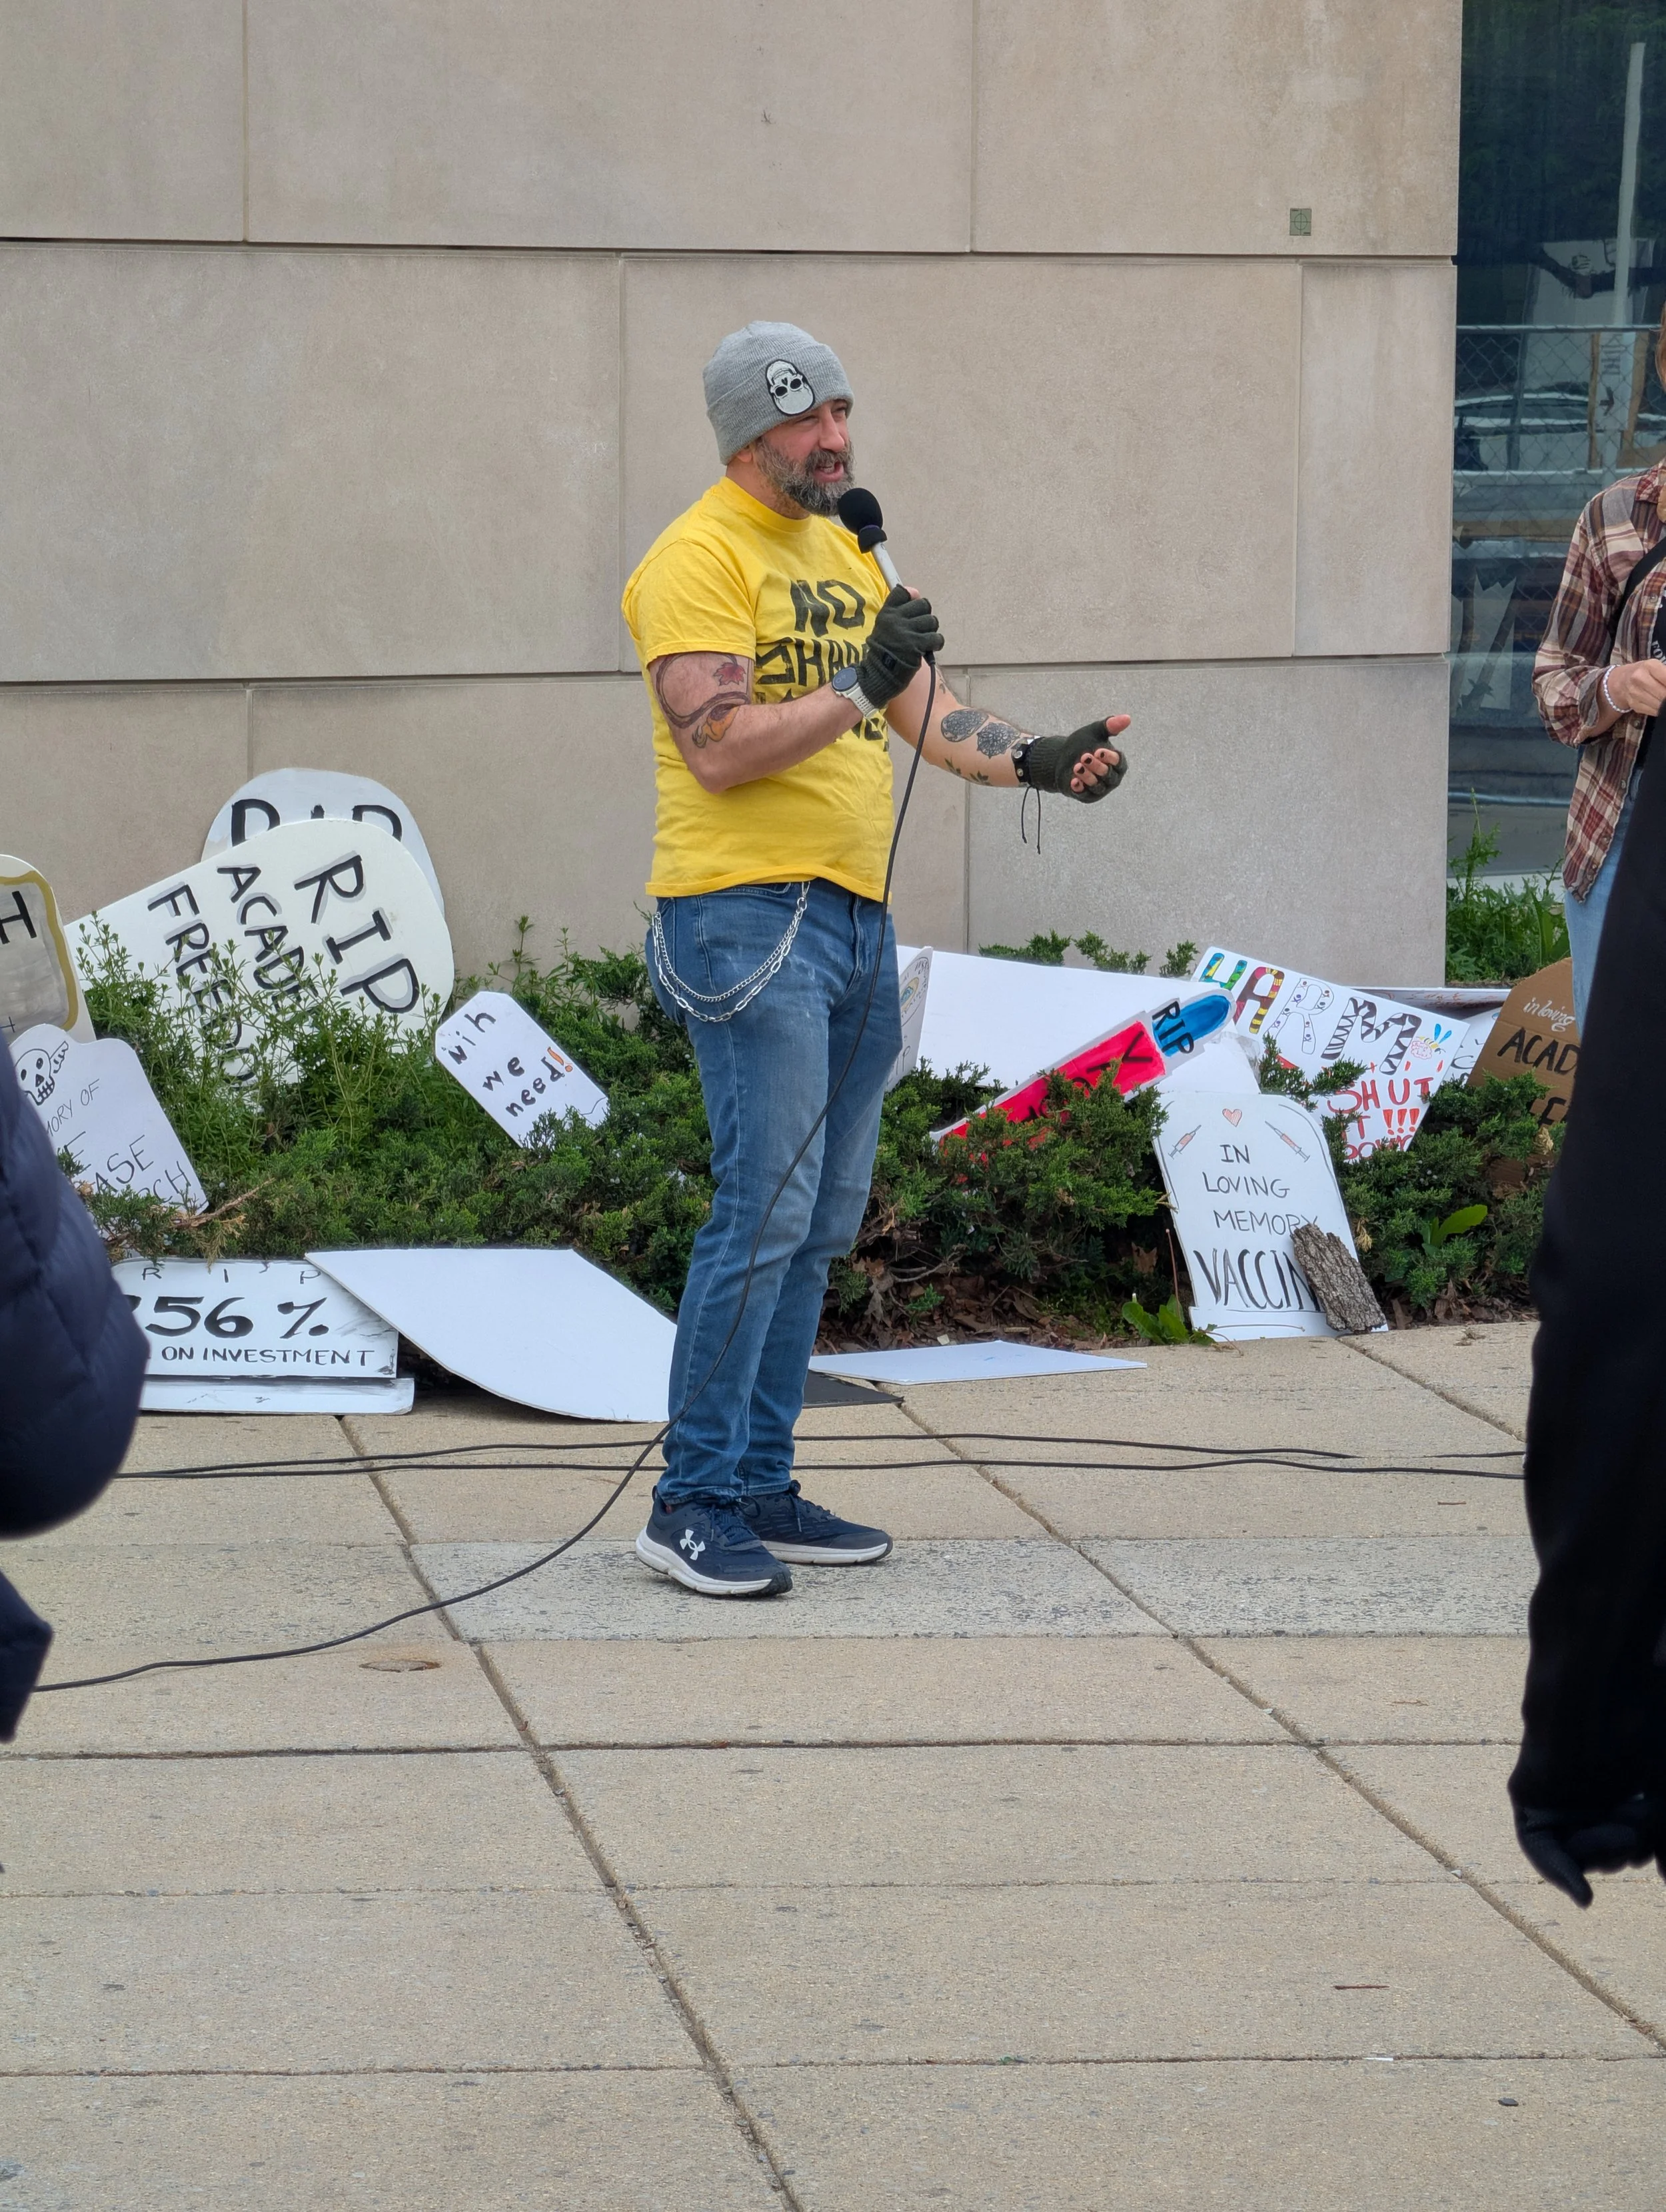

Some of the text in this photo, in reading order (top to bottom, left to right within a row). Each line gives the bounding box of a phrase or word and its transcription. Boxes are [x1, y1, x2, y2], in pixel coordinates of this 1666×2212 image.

[790, 578, 866, 637] NO
[217, 866, 319, 1014] ACADE
[294, 854, 420, 1014] RIP
[148, 884, 257, 1084] FREEDO
[1152, 1001, 1194, 1054] RIP
[1199, 952, 1422, 1075] HARM
[1523, 997, 1577, 1032] in loving
[482, 1057, 525, 1091] we
[1497, 1027, 1581, 1075] ACAD
[80, 1079, 99, 1106] OF
[505, 1046, 574, 1117] need!
[1327, 1077, 1433, 1113] SHUT
[1220, 1144, 1250, 1164] IN
[1202, 1171, 1290, 1199] LOVING
[1214, 1209, 1318, 1235] MEMORY
[1193, 1248, 1321, 1312] VACCIN
[161, 1346, 375, 1367] ON INVESTMENT
